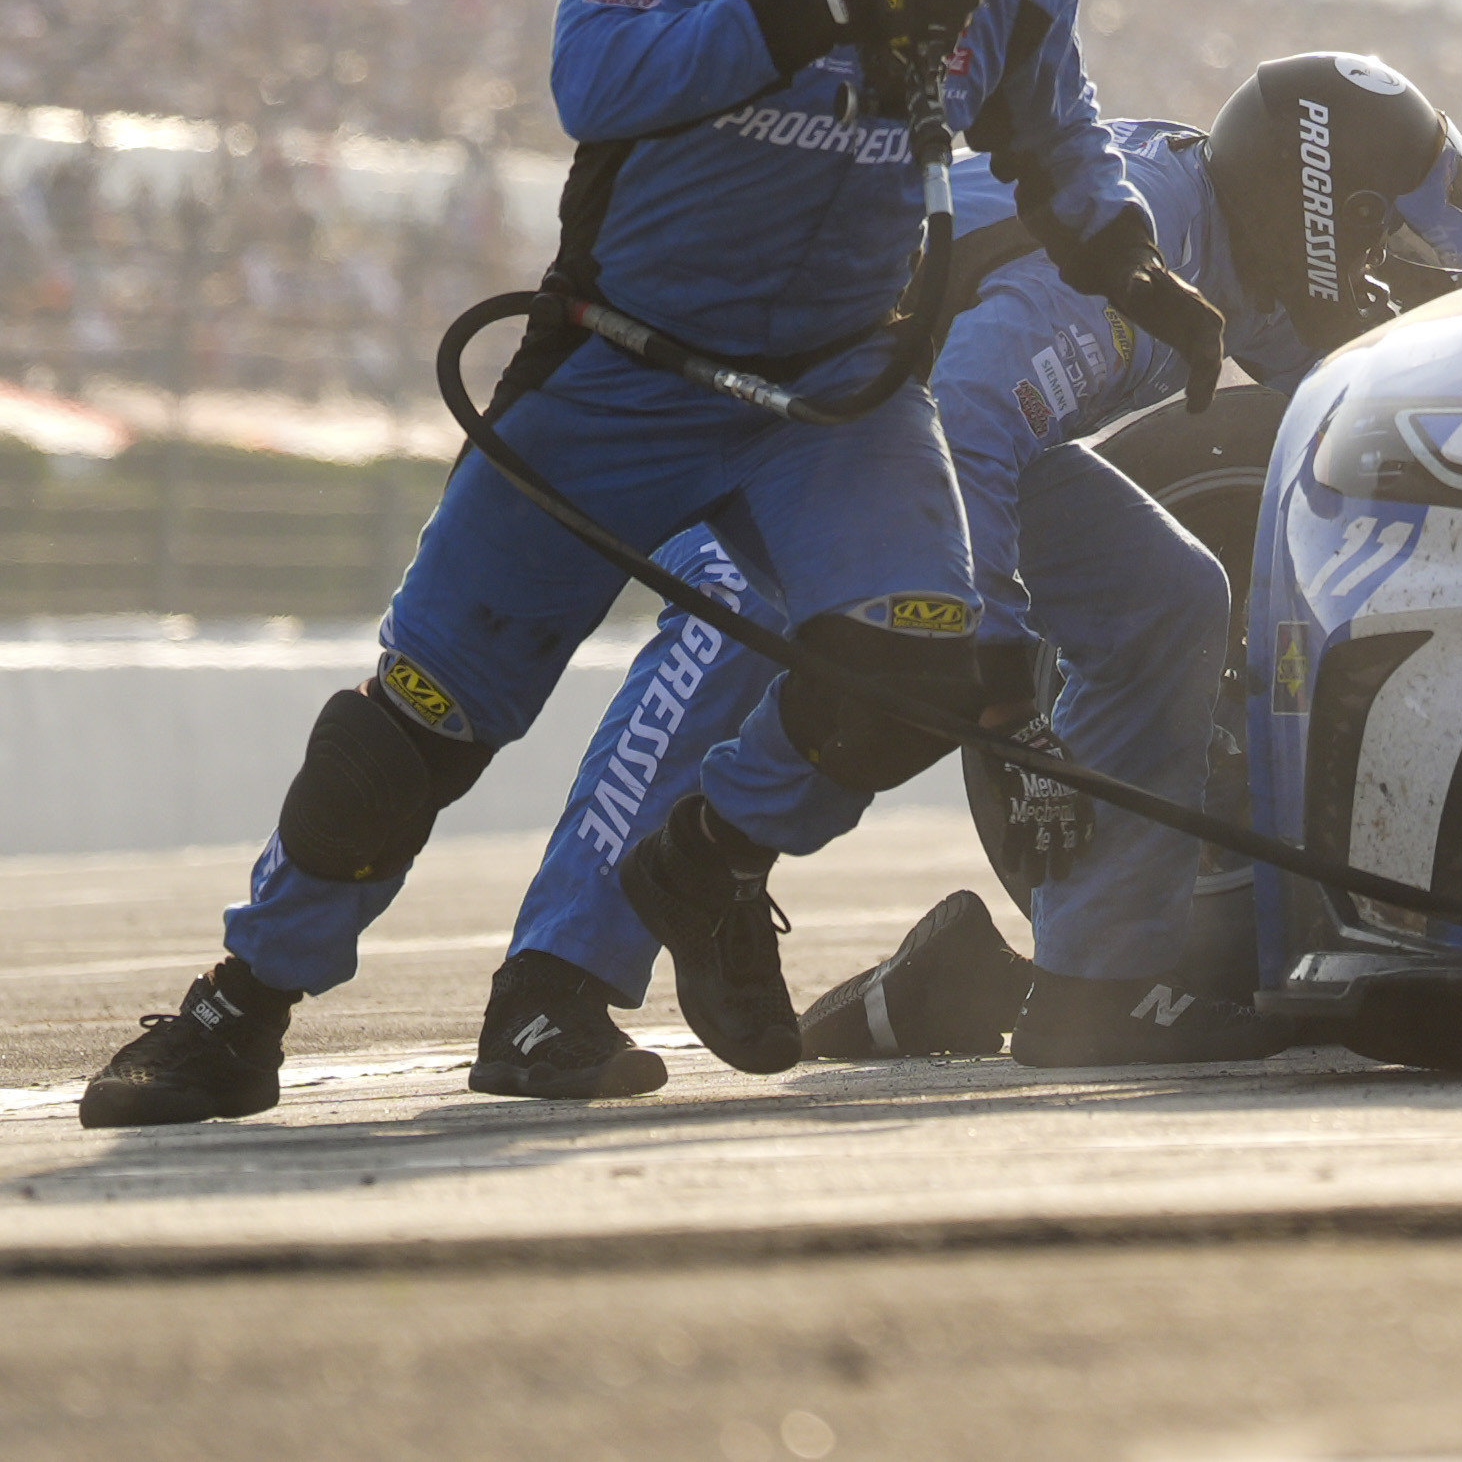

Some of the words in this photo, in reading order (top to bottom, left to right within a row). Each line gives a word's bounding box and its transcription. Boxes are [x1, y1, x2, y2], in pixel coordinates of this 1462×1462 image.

[1298, 99, 1340, 302] PROGRESSIVE
[1041, 358, 1068, 412] SIEMENS
[1309, 515, 1417, 598] 11
[195, 1002, 221, 1026] OMP
